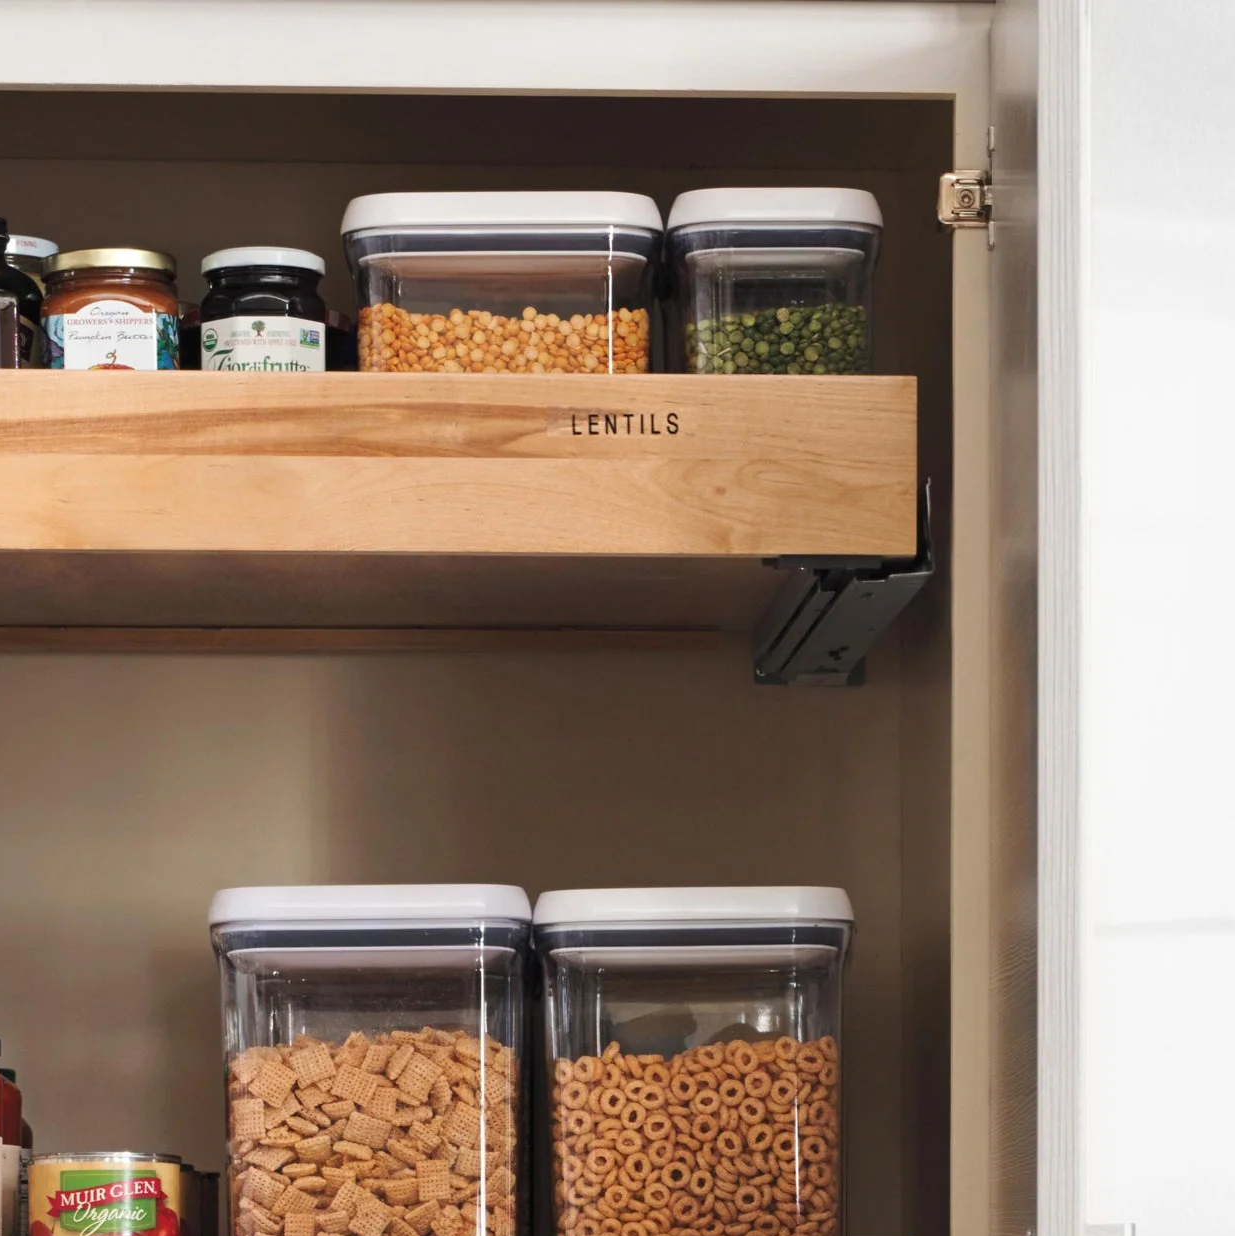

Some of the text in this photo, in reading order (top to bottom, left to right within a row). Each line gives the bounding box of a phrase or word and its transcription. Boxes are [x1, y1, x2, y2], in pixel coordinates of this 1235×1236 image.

[572, 412, 680, 435] LENTILS
[61, 1180, 155, 1207] MUIR GLEN
